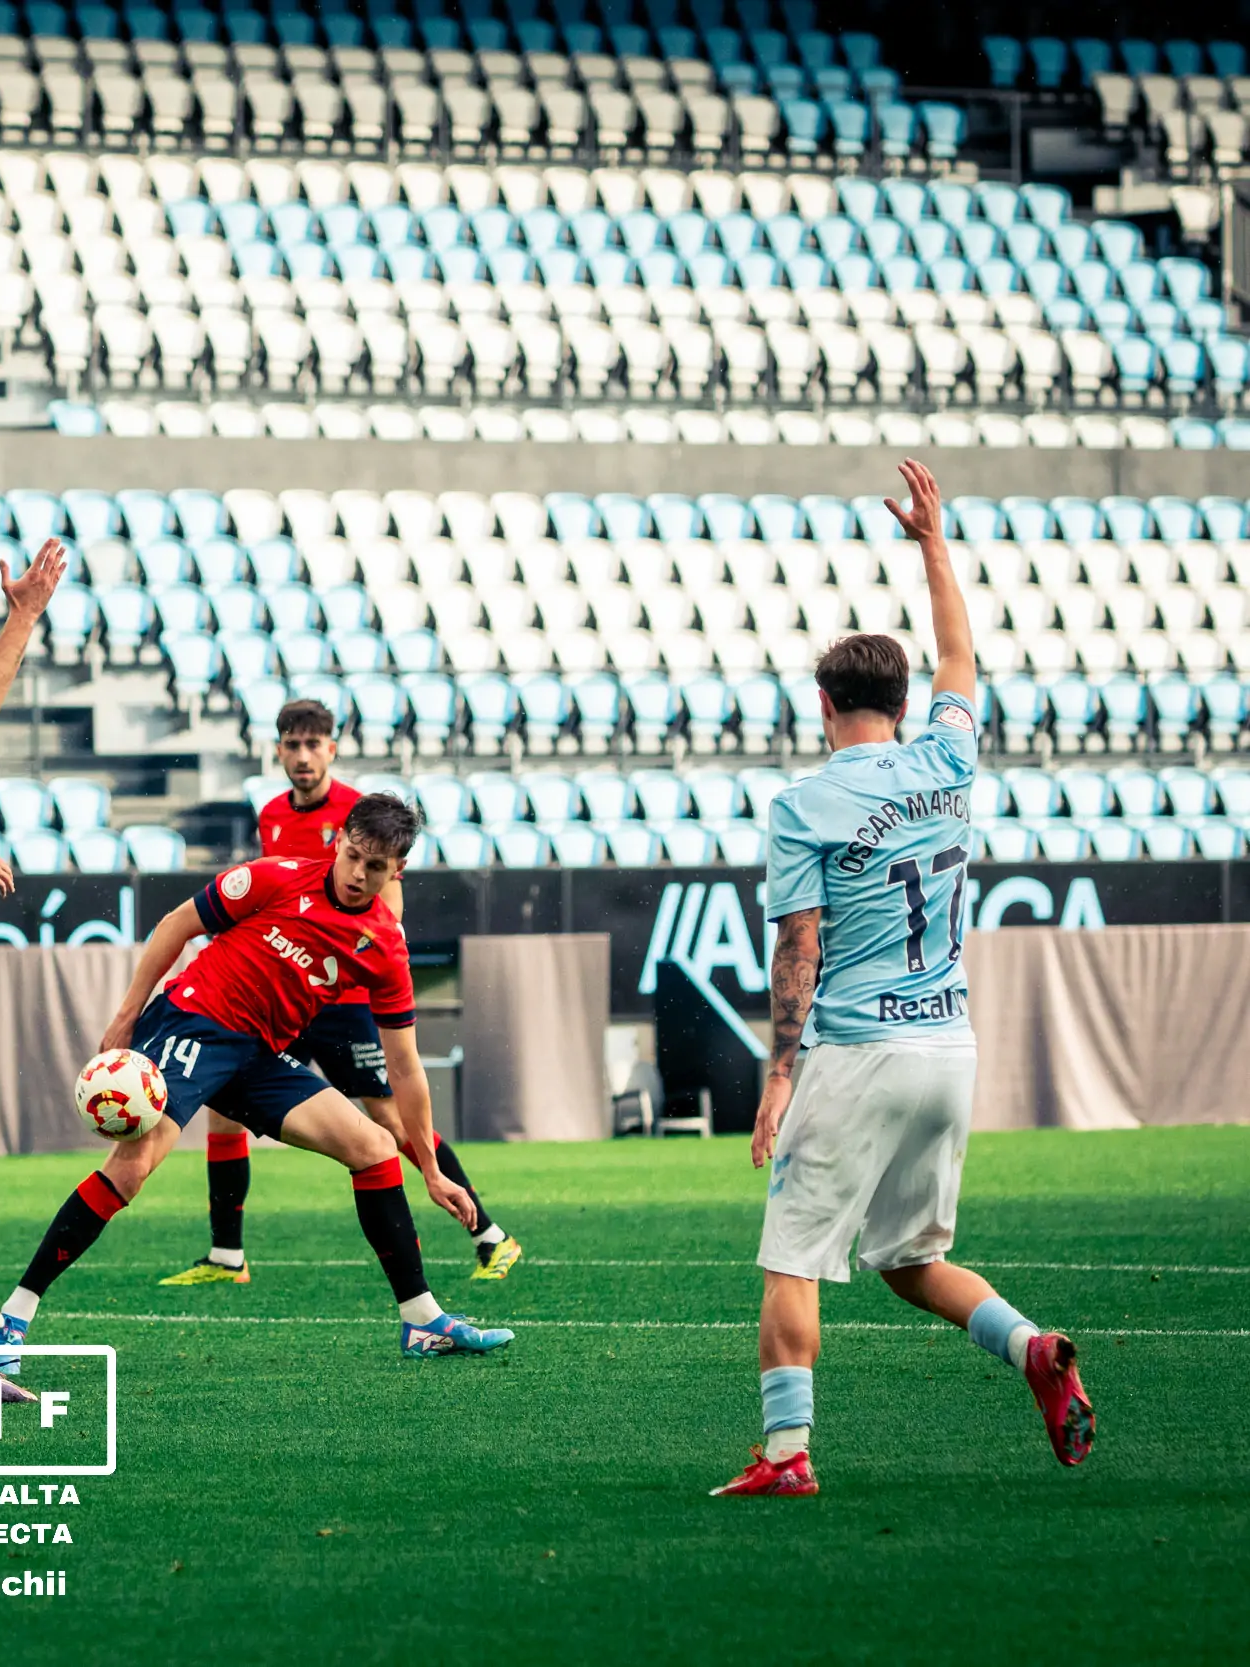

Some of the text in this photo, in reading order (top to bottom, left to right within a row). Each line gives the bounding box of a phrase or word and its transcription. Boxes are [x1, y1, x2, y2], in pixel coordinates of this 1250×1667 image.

[834, 789, 971, 874] ÓSCAR MARCO
[887, 845, 968, 973] 17
[263, 926, 313, 969] Jaylo
[159, 1035, 202, 1079] 14
